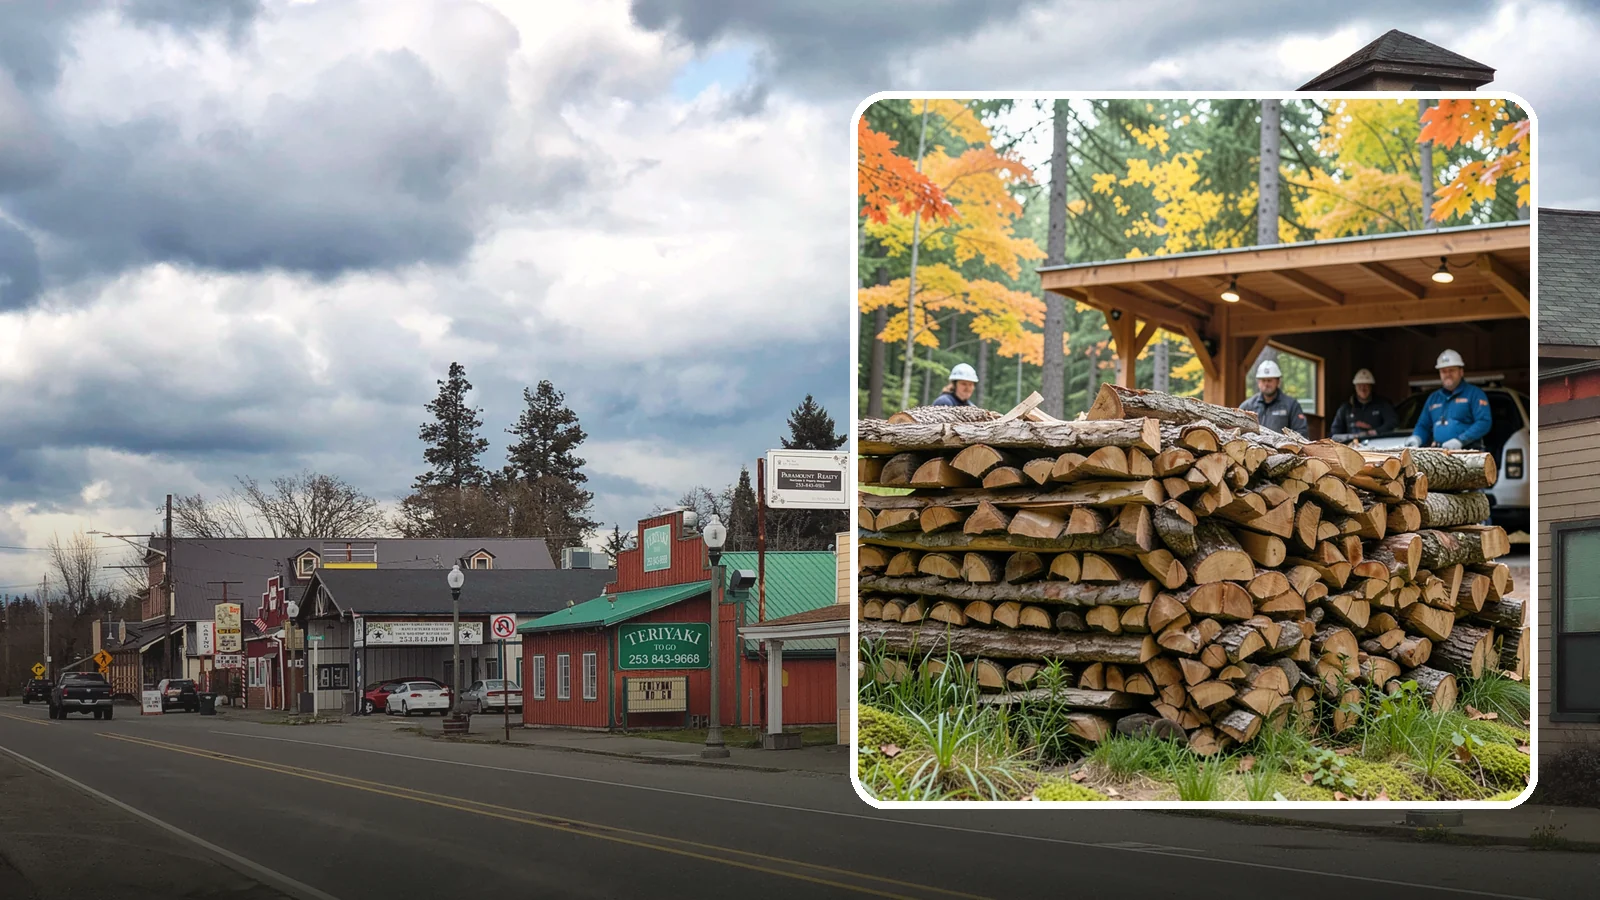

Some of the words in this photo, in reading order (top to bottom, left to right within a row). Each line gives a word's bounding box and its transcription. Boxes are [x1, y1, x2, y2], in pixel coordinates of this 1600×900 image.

[781, 471, 815, 479] PARAMOUNT
[817, 472, 839, 480] REALTY
[625, 627, 702, 646] TERIYAKI
[628, 654, 649, 664] 253
[651, 653, 700, 664] 843-9668
[639, 681, 673, 691] TERIYAKI
